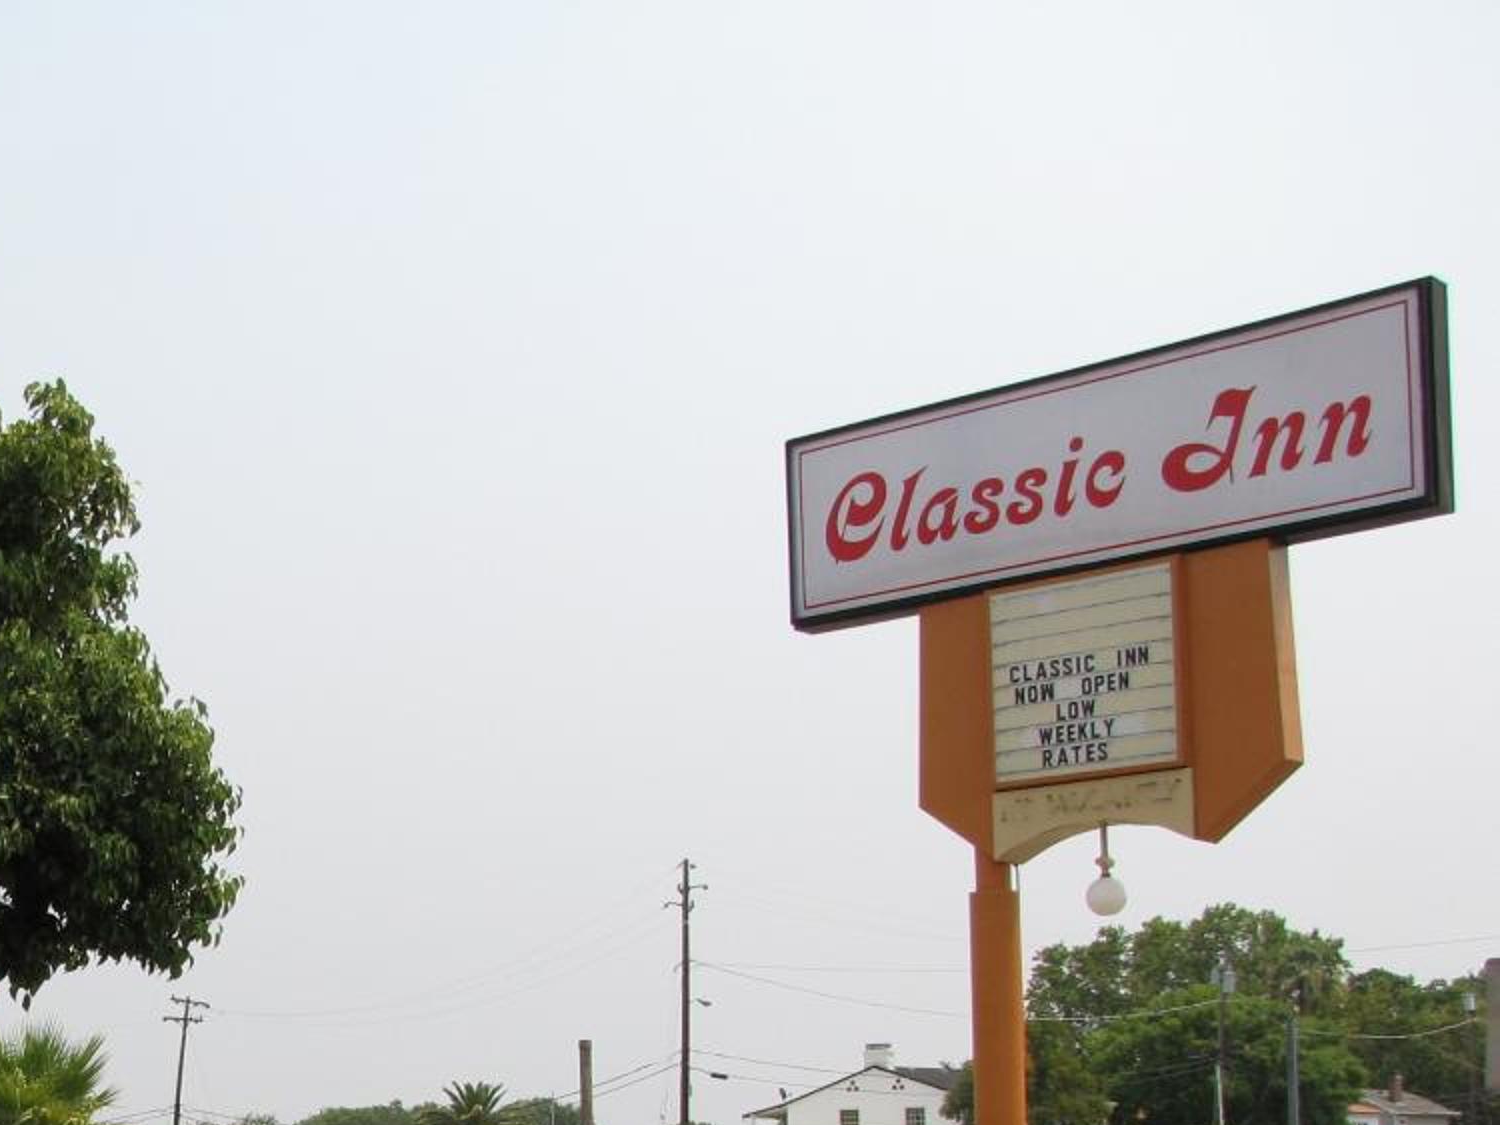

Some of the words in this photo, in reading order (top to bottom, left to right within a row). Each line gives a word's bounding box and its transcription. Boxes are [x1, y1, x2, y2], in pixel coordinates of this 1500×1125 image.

[825, 436, 1126, 564] Classic
[1160, 384, 1373, 493] Inn
[1008, 653, 1096, 684] CLASSIC
[1116, 645, 1150, 668] INN
[1014, 682, 1055, 705] NOW
[1081, 671, 1130, 696] OPEN
[1055, 700, 1096, 722] LOW
[1039, 718, 1116, 746] WEEKLY
[1041, 742, 1109, 769] RATES
